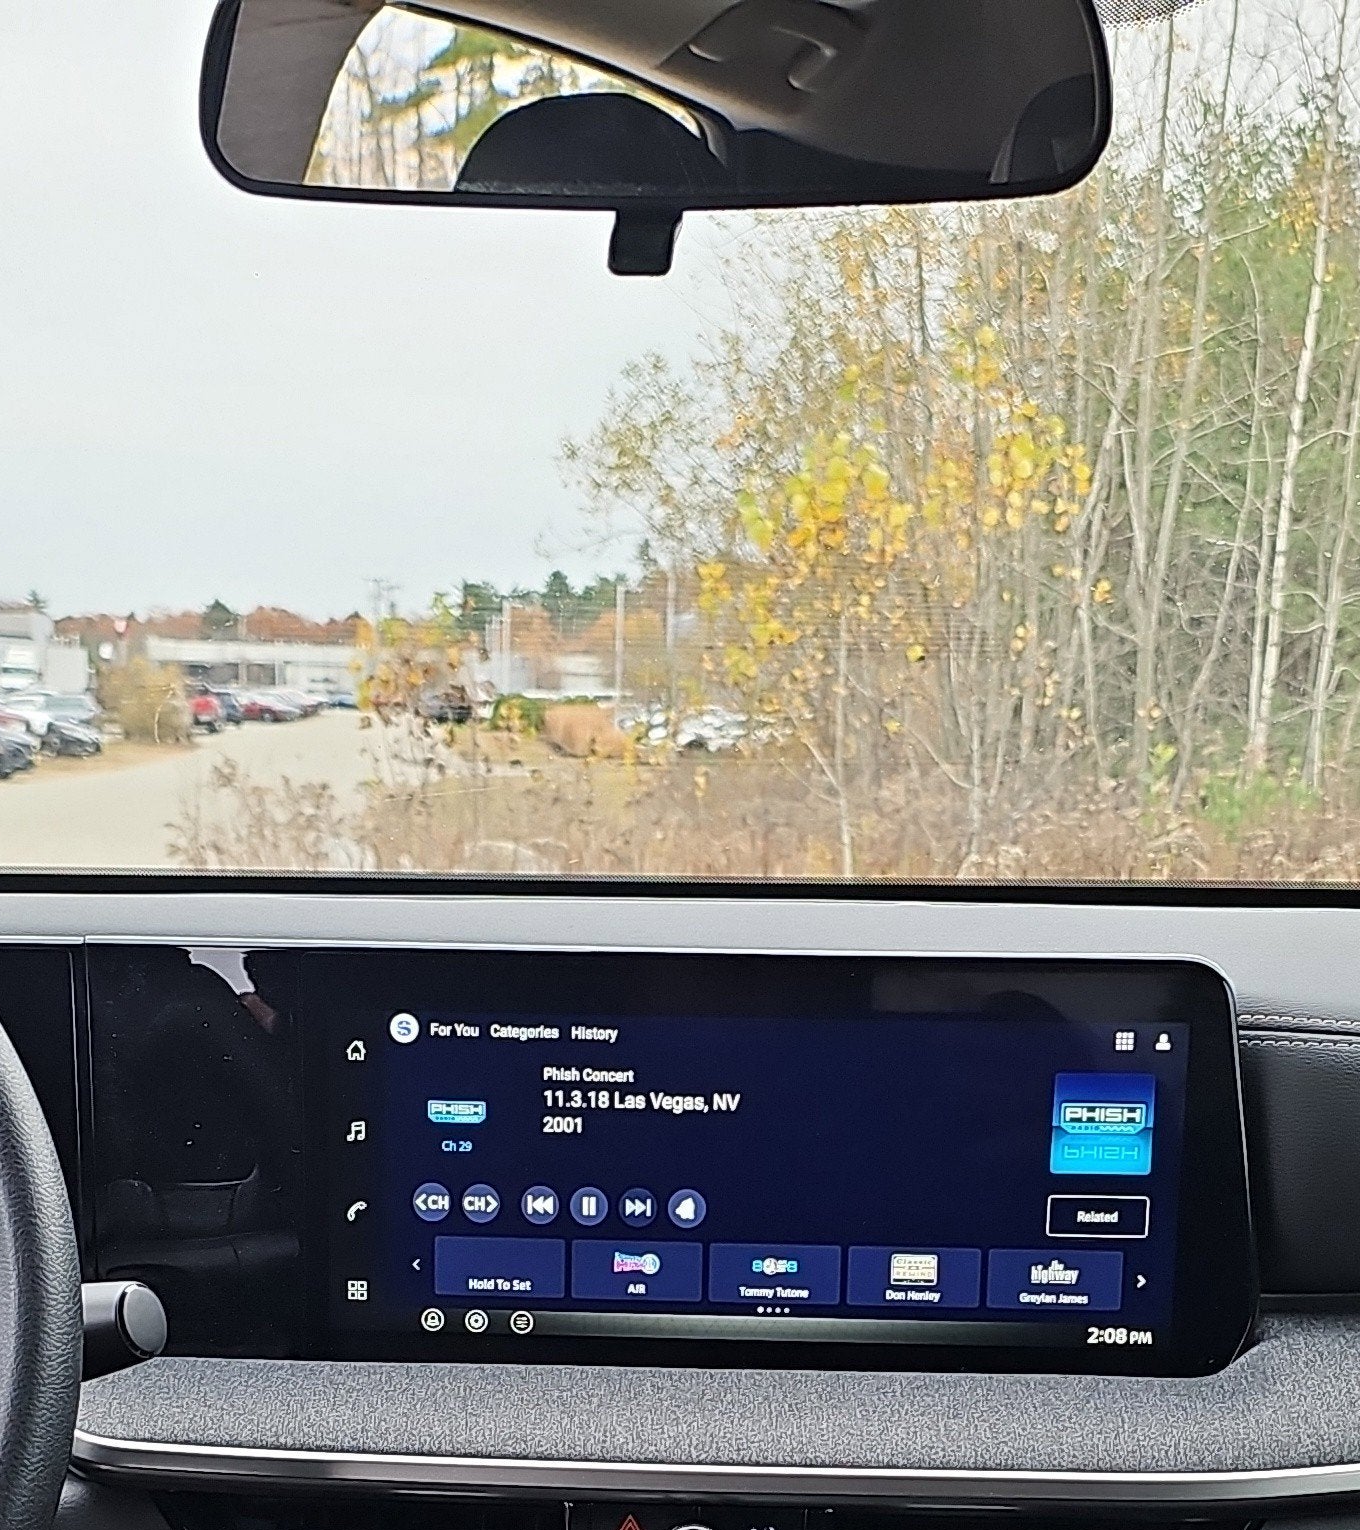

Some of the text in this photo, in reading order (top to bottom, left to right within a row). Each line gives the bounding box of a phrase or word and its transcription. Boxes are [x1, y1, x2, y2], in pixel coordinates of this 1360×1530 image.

[430, 1023, 619, 1043] For You Categories History
[543, 1067, 635, 1083] Phish Concert
[543, 1090, 740, 1114] 11.3.18 Las Vegas, NV
[430, 1103, 484, 1117] PHISH
[1065, 1107, 1141, 1122] PHISH
[543, 1116, 583, 1133] 2001
[441, 1140, 473, 1152] Ch 29
[1077, 1211, 1119, 1223] Related
[1031, 1265, 1080, 1284] highway
[468, 1278, 532, 1292] Hold To Set
[739, 1287, 809, 1298] Tommy Tutone
[885, 1290, 941, 1303] Don Henley
[1057, 1294, 1089, 1305] James
[1087, 1327, 1153, 1345] 2:08 PM
